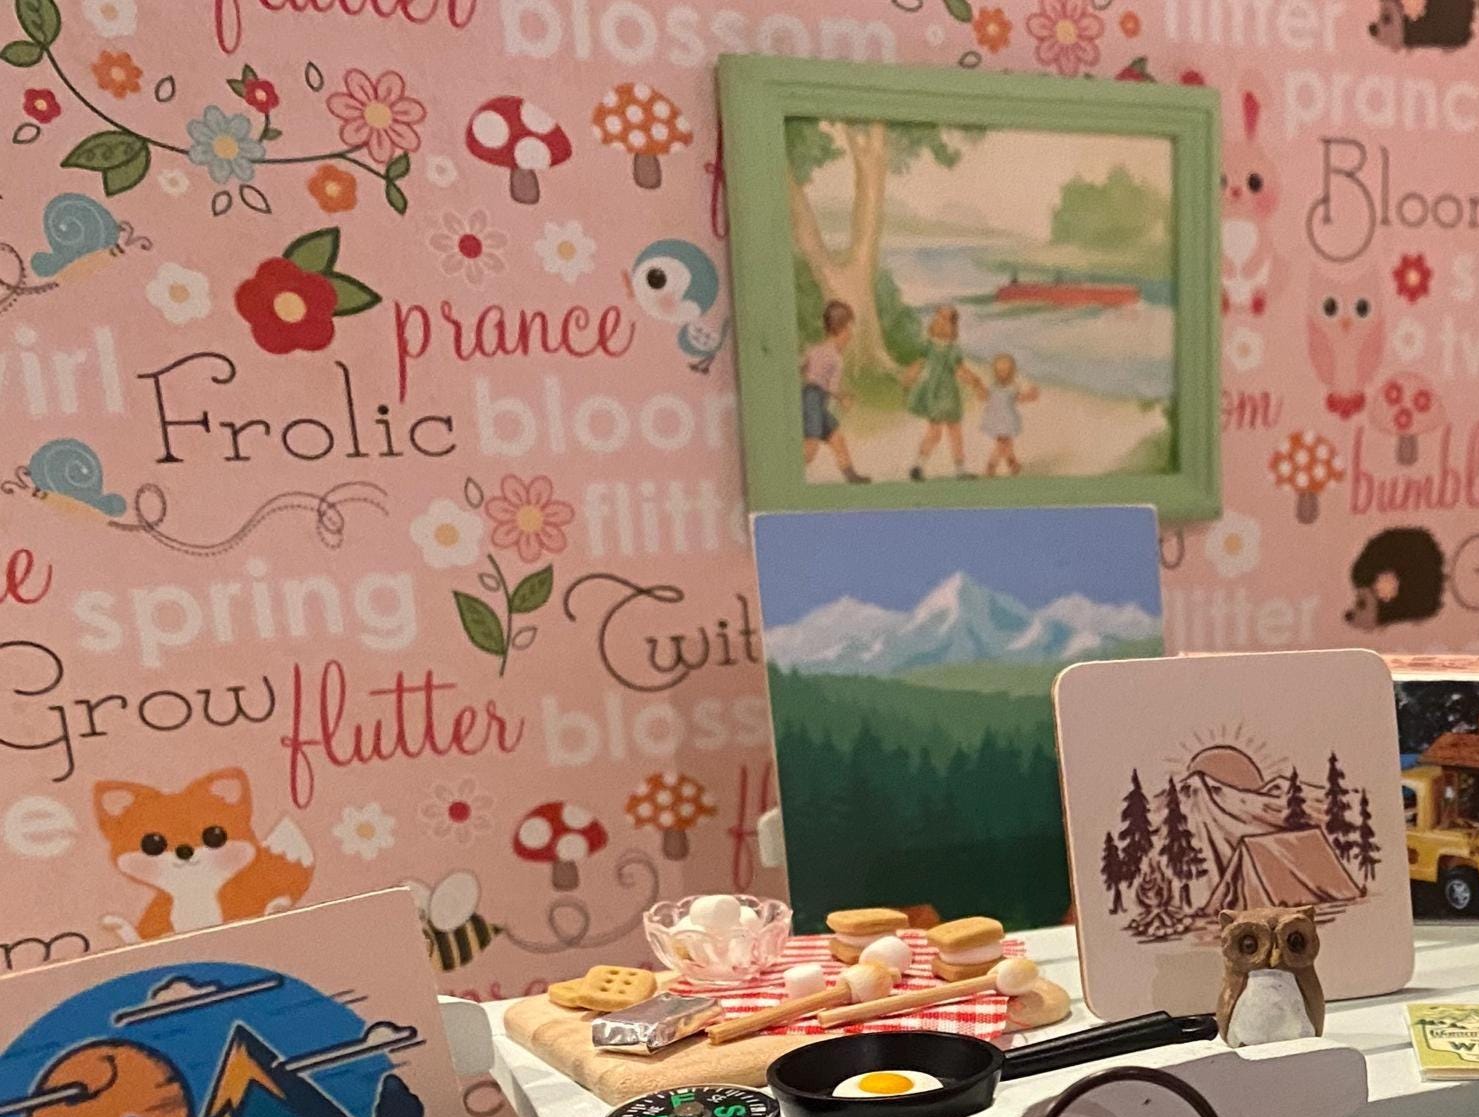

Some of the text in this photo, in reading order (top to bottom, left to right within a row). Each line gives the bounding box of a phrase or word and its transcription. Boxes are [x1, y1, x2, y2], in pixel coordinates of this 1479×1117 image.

[137, 351, 457, 464] Frolic
[393, 300, 636, 403] prance
[584, 480, 746, 558] flitt
[73, 556, 418, 668] spring
[563, 572, 759, 693] Twit
[281, 658, 525, 809] flutter
[543, 695, 772, 768] bloss
